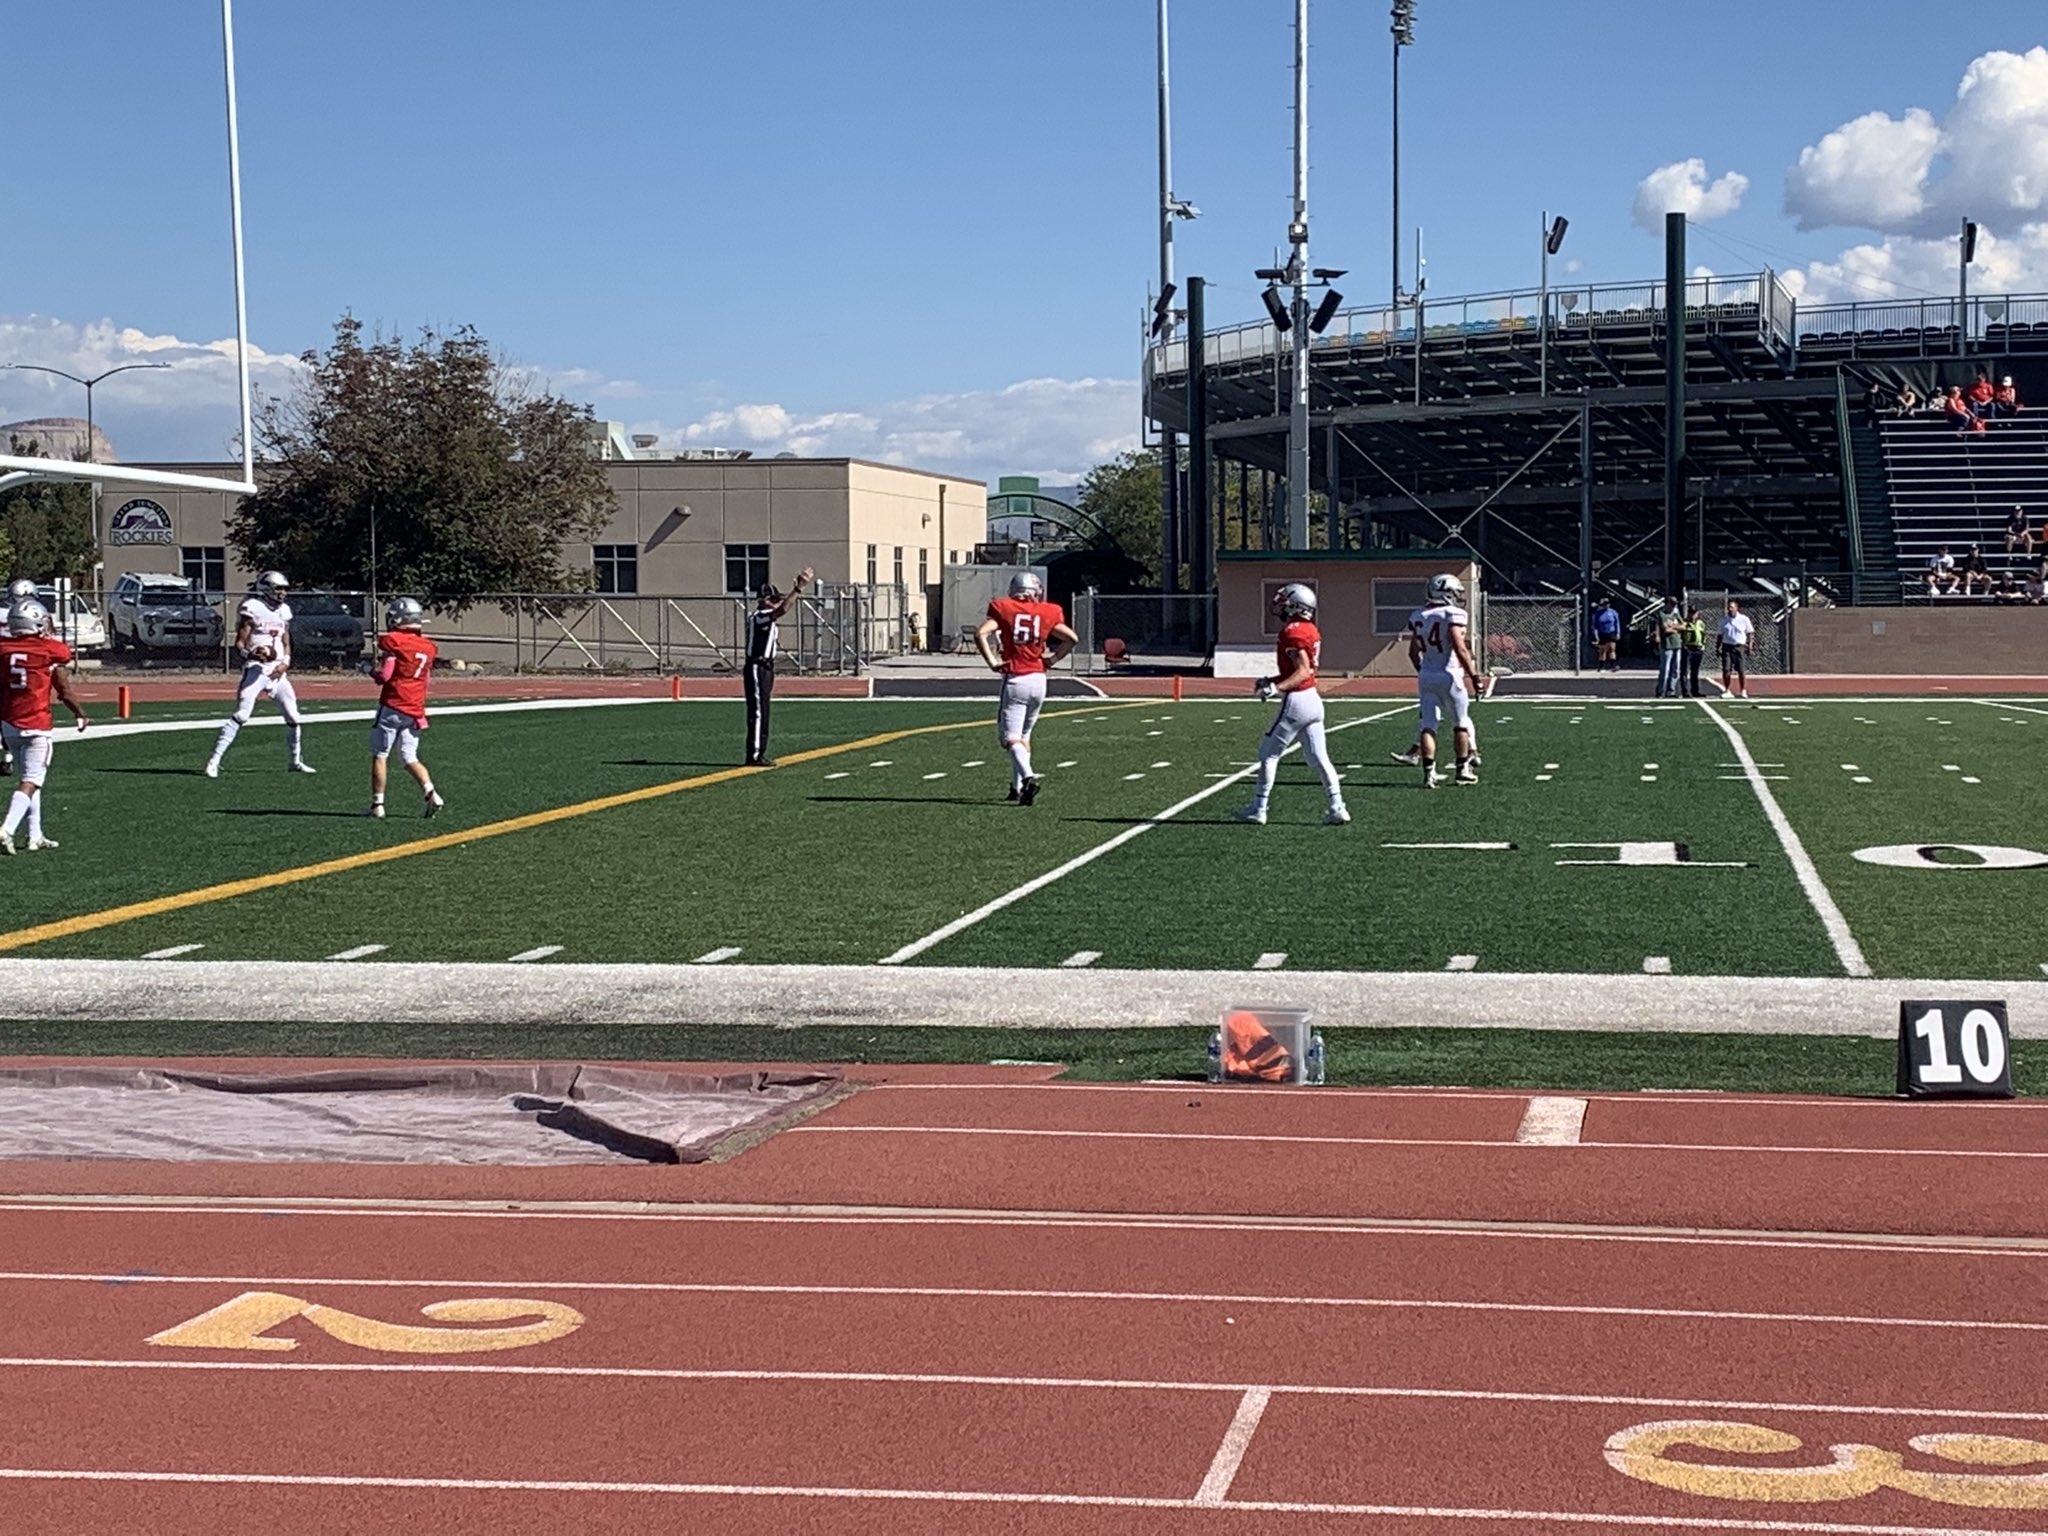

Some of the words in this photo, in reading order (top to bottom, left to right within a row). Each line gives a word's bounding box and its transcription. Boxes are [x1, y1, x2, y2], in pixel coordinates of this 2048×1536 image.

[111, 531, 173, 545] ROCKIES
[1013, 613, 1041, 643] 61
[9, 653, 28, 689] 5
[414, 652, 428, 678] 7
[1915, 1008, 2005, 1083] 10
[143, 1291, 586, 1353] 2
